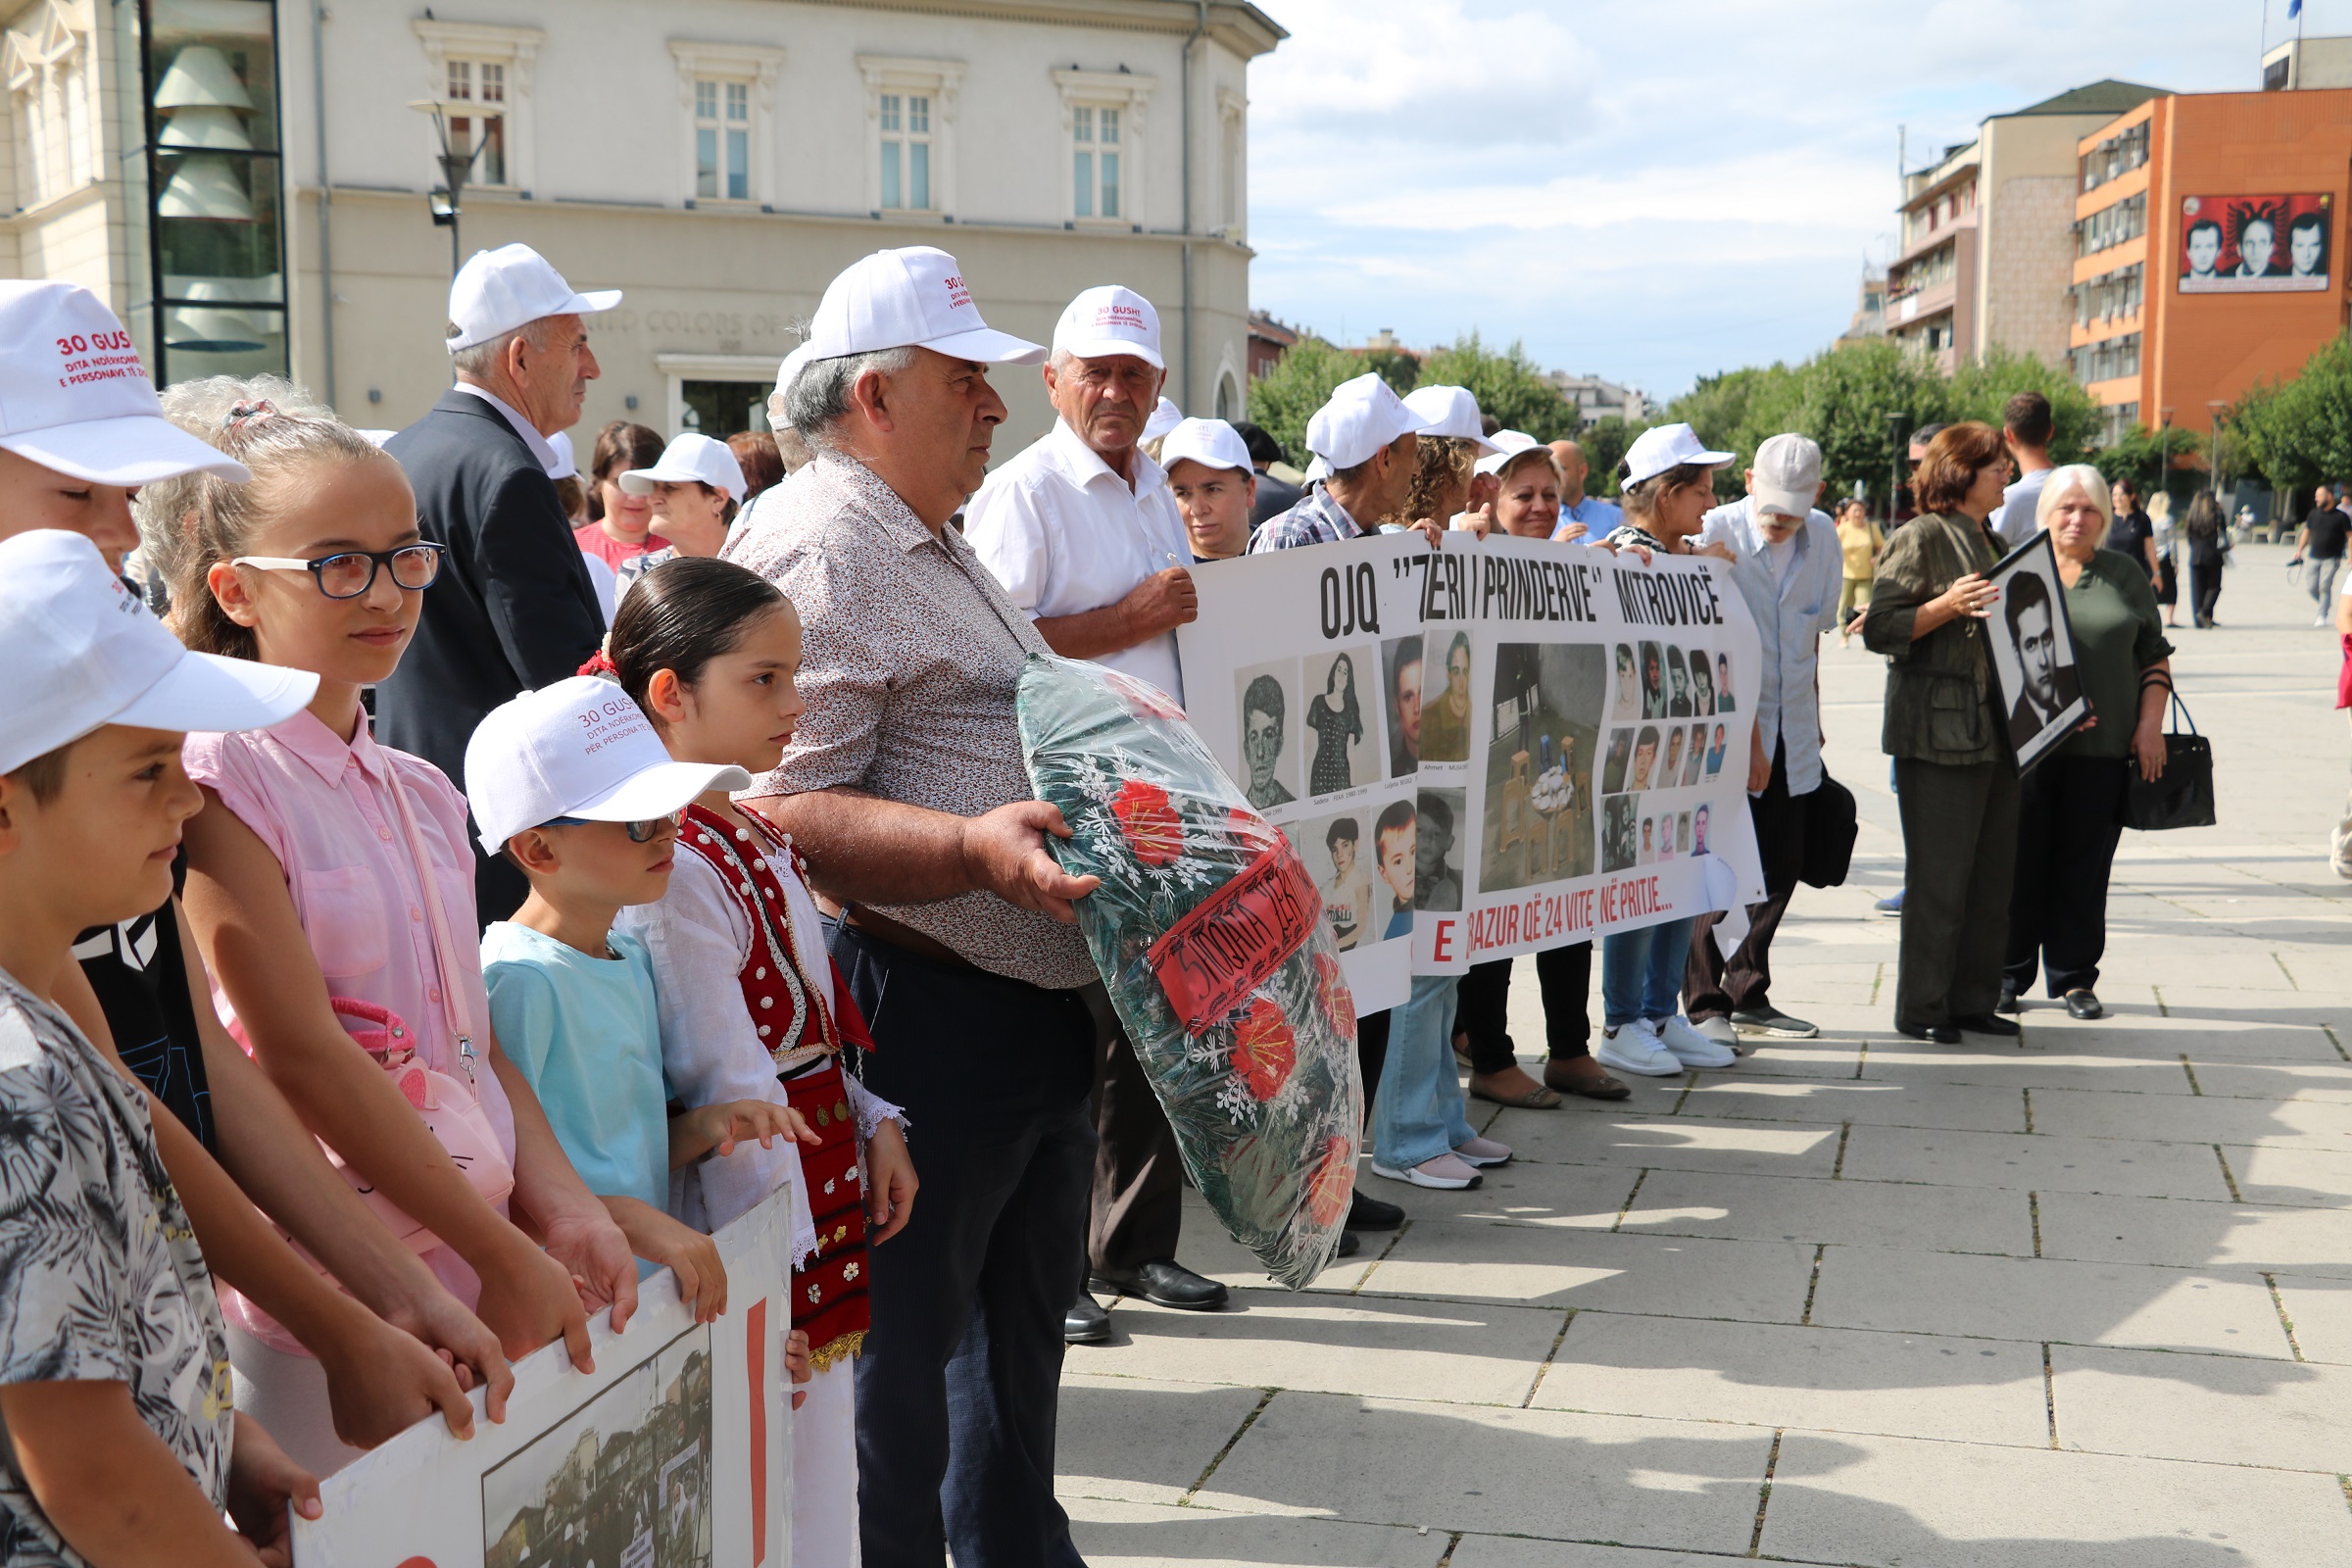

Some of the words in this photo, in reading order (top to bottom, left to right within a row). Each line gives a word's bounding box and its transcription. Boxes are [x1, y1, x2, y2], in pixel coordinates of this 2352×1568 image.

[945, 277, 957, 289] 30
[1098, 306, 1109, 316] 30
[1112, 306, 1141, 318] GUSHT
[56, 334, 88, 356] 30
[91, 330, 131, 351] GUS
[65, 360, 90, 372] DITA
[60, 378, 67, 388] E
[69, 368, 126, 385] PERSONAVE
[1320, 562, 1380, 639] OJQ
[1612, 564, 1723, 626] MITROVICË
[578, 710, 601, 728] 30
[585, 742, 604, 756] PËR
[603, 726, 639, 746] PERSONA
[587, 724, 610, 740] DITA
[1433, 919, 1456, 962] E
[1523, 892, 1542, 944] QË
[1544, 895, 1562, 937] 24
[1566, 888, 1594, 932] VITE
[1599, 878, 1617, 924] NË
